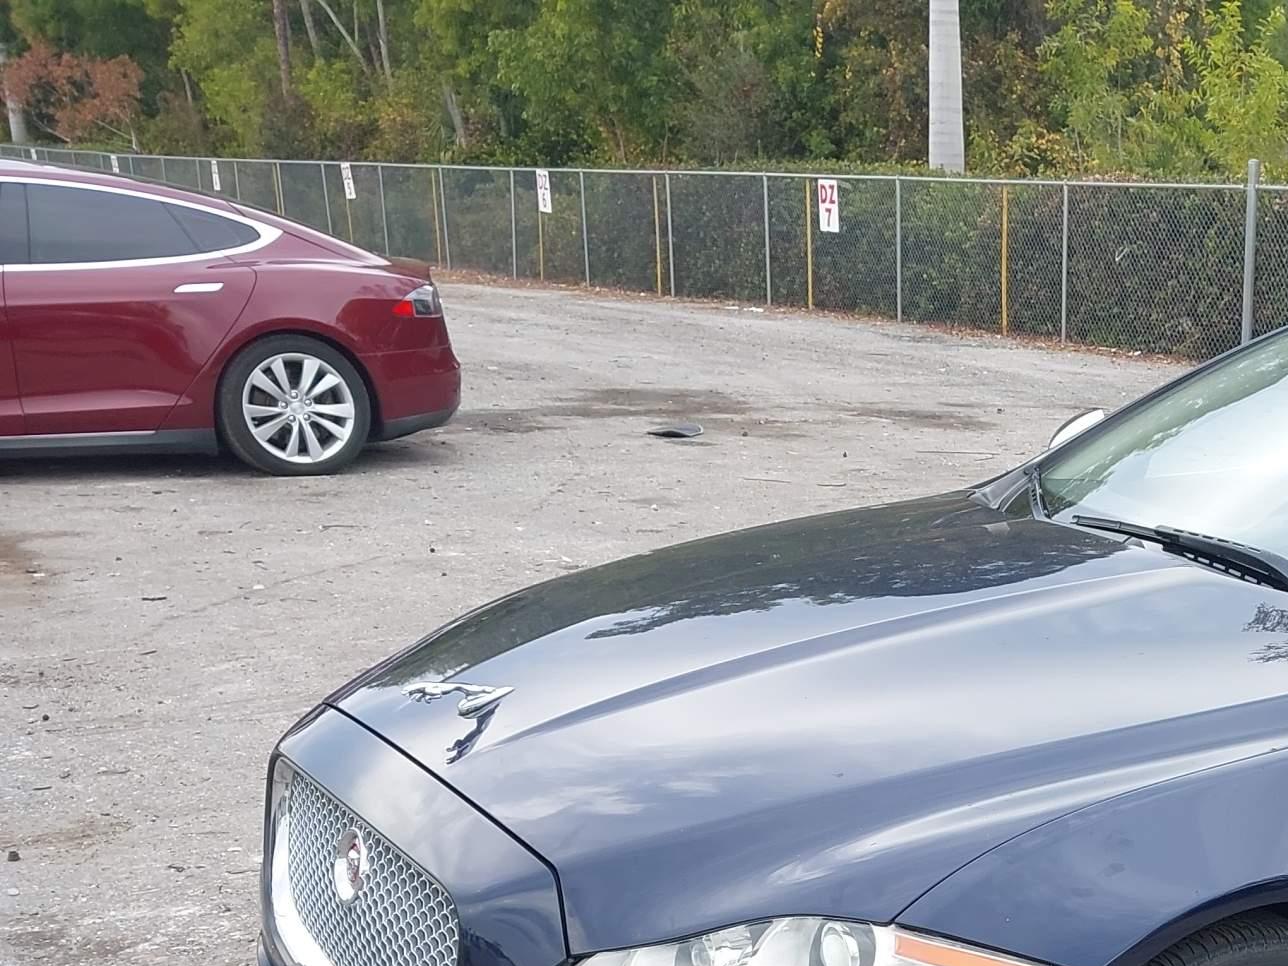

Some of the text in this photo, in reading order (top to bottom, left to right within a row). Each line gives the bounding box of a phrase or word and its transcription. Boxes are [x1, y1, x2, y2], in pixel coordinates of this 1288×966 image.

[537, 173, 549, 191] DZ
[819, 183, 837, 204] DZ
[824, 207, 833, 228] 7
